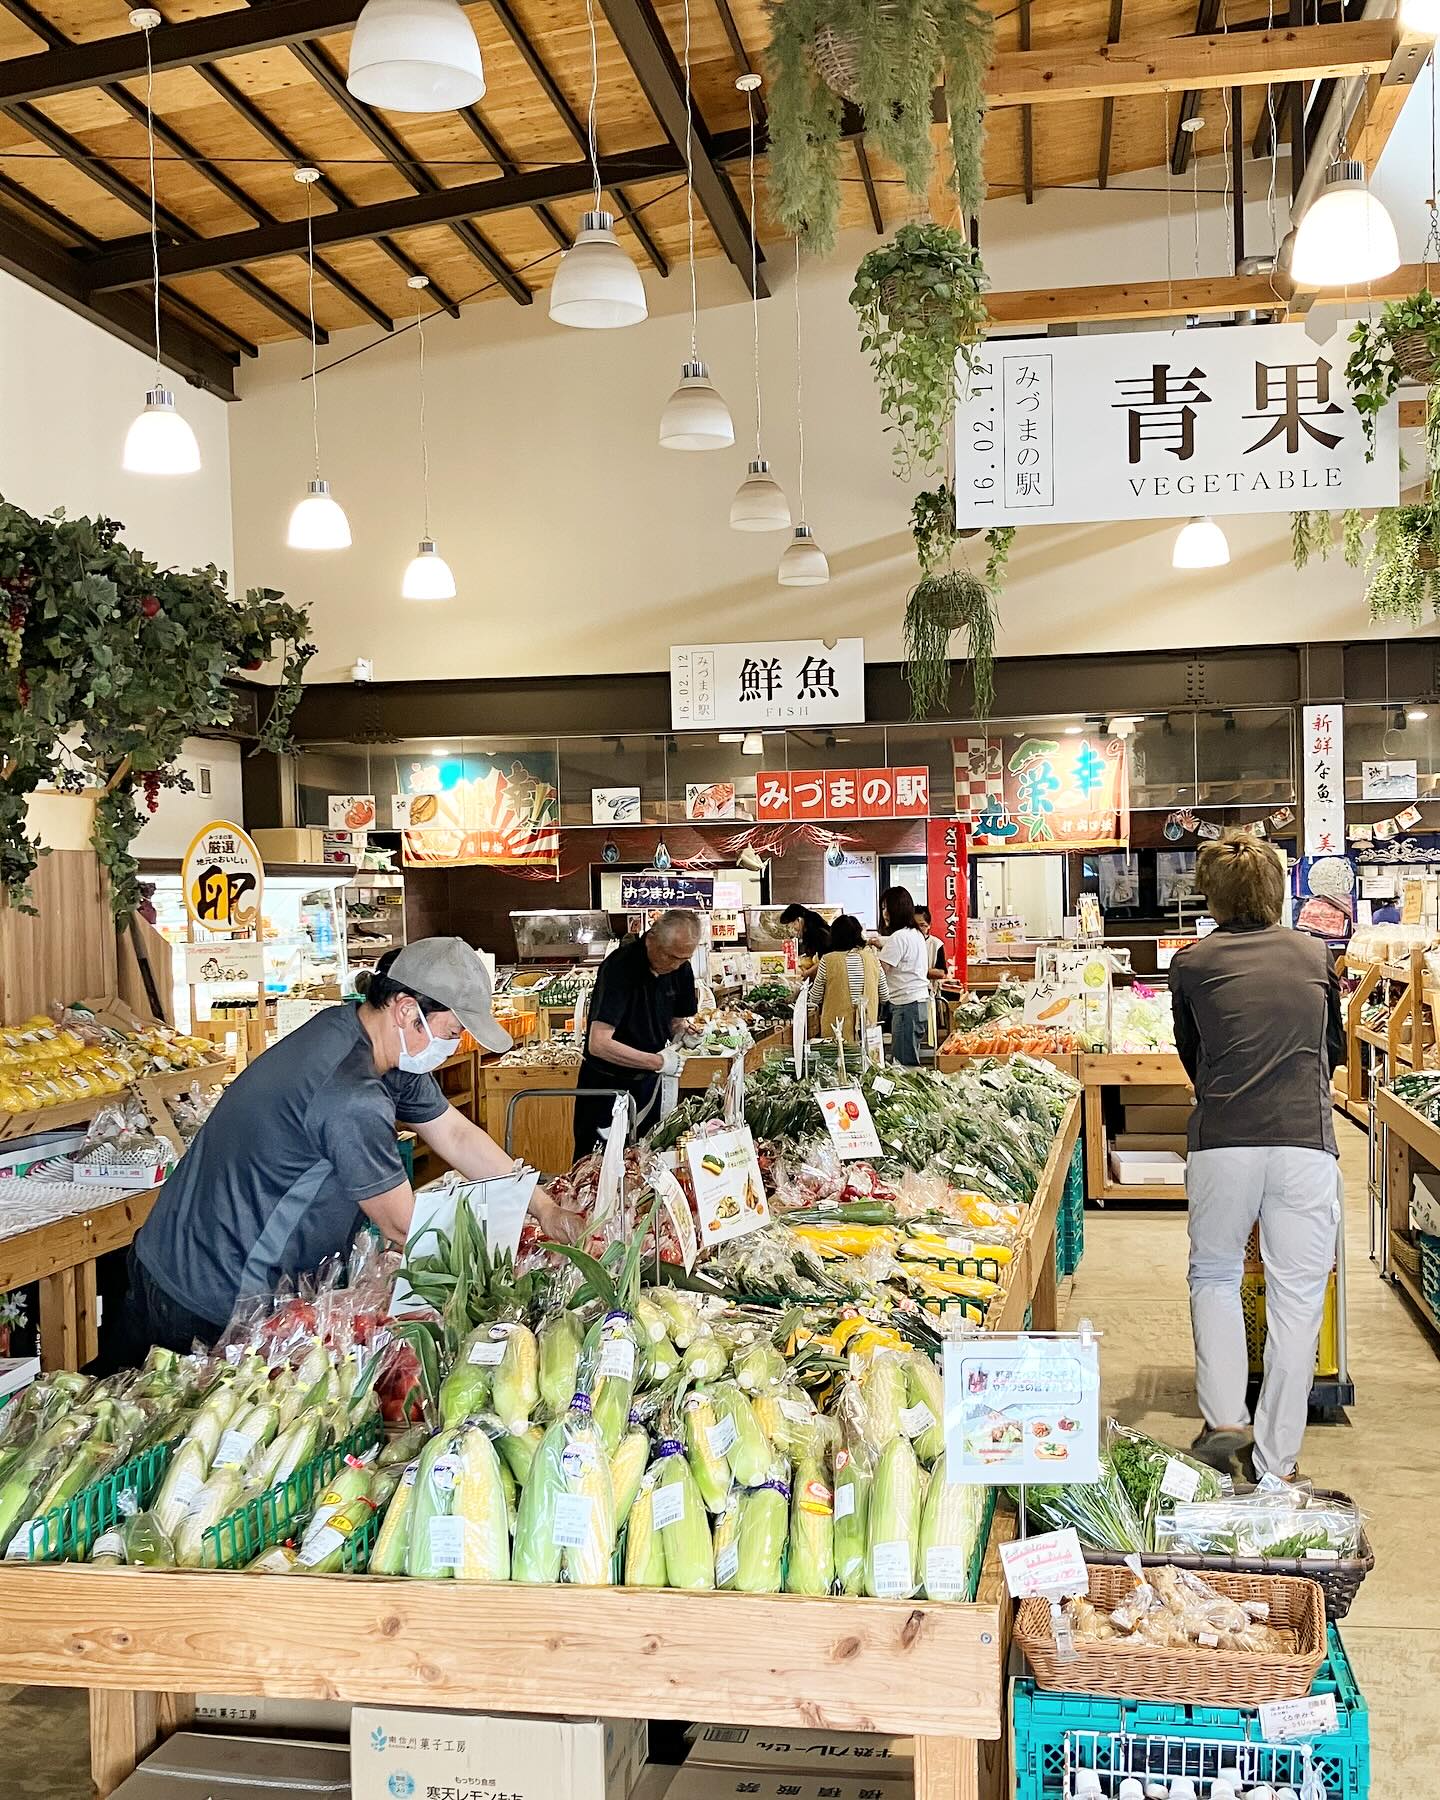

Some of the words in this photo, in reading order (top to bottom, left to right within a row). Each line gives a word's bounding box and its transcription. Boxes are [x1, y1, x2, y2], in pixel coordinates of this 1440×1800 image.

[1015, 365, 1042, 497] みづまの駅
[1111, 356, 1344, 464] 青果
[971, 363, 996, 507] 16.02.12
[1128, 467, 1343, 498] VEGETABLE
[677, 654, 690, 720] 16.02.12
[696, 656, 711, 716] みづまの駅
[738, 655, 840, 702] 鮮魚
[765, 705, 809, 718] FISH
[758, 775, 928, 810] みづまの駅
[196, 856, 248, 866] 地元のおいしい
[208, 840, 235, 854] 厳選
[197, 865, 256, 921] 卵
[455, 1776, 497, 1787] もっちり食感
